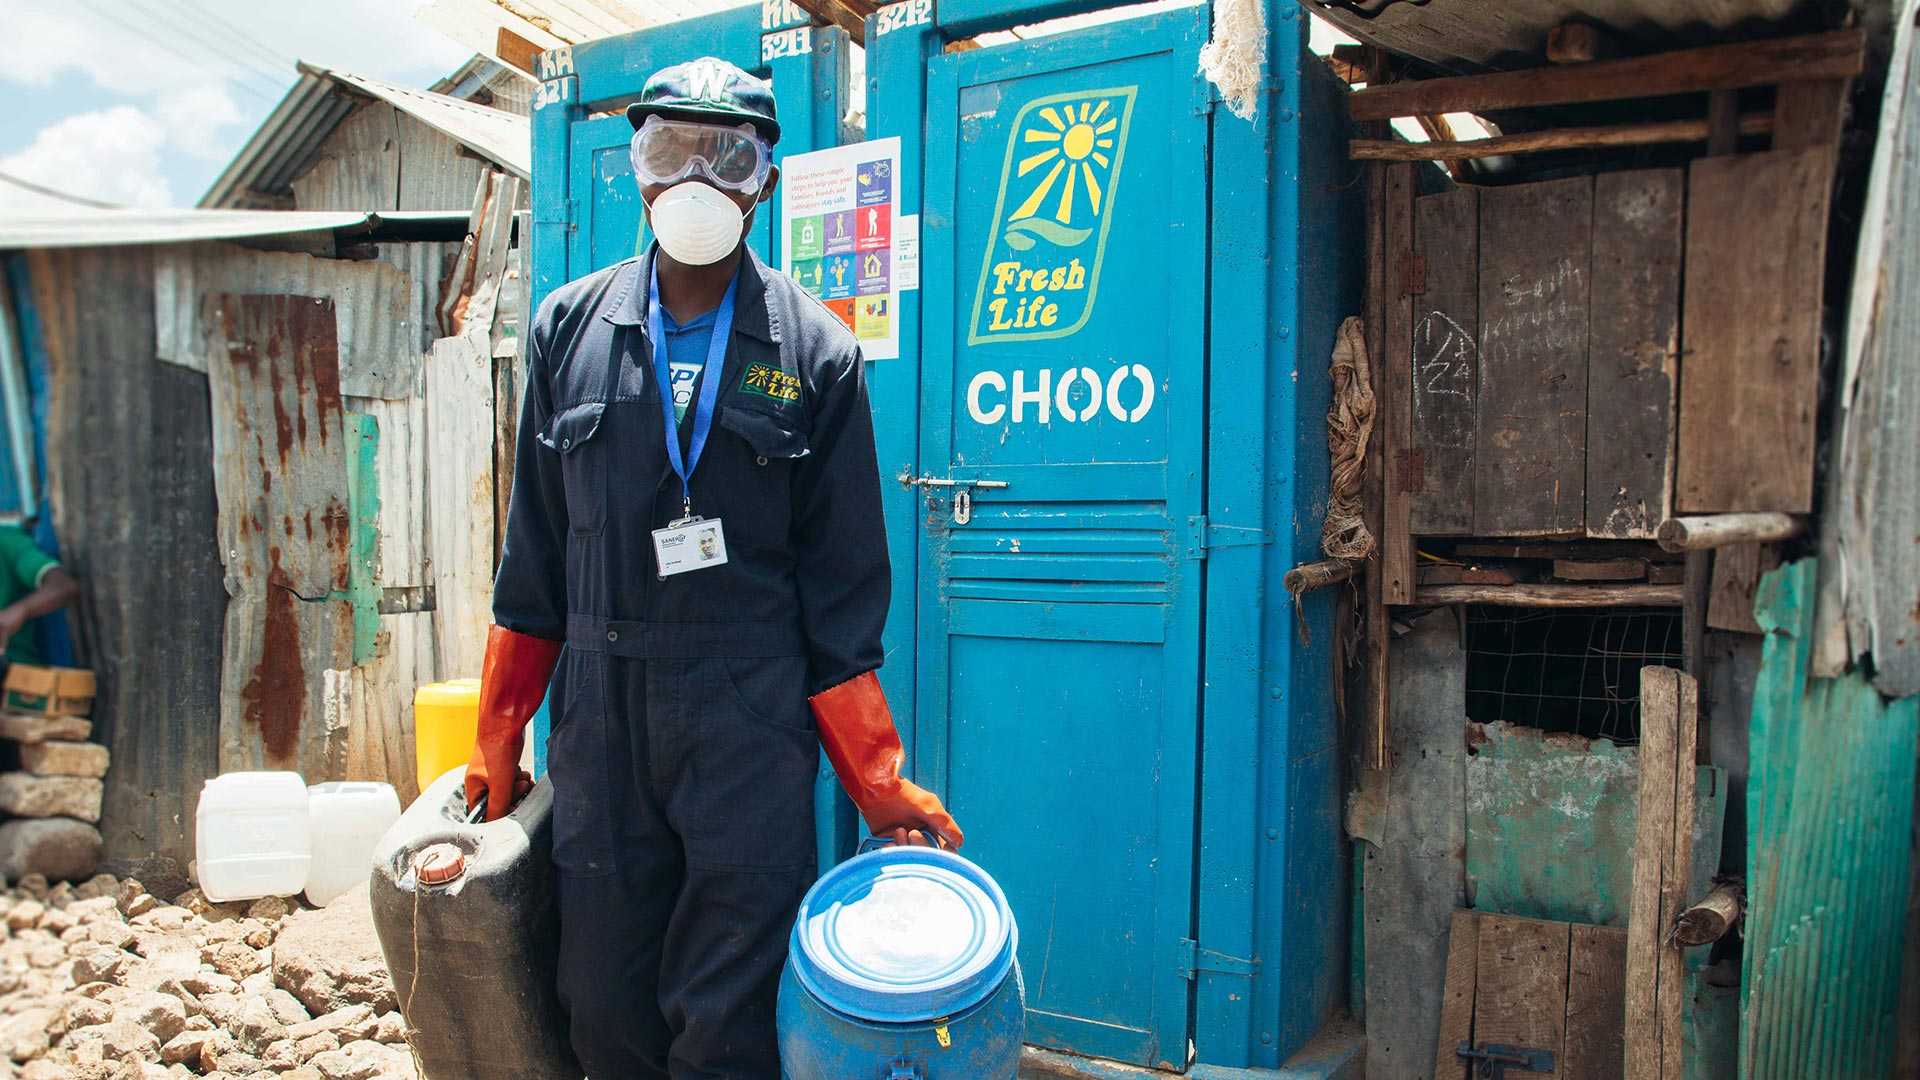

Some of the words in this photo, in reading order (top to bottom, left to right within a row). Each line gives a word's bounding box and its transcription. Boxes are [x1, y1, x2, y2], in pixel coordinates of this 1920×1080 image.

[876, 0, 932, 36] 3212
[762, 26, 812, 61] 3211
[688, 62, 730, 102] W
[992, 258, 1086, 295] Fresh
[988, 295, 1059, 331] Life
[767, 382, 800, 400] Life
[771, 370, 801, 388] Fres
[967, 363, 1155, 425] CHOO
